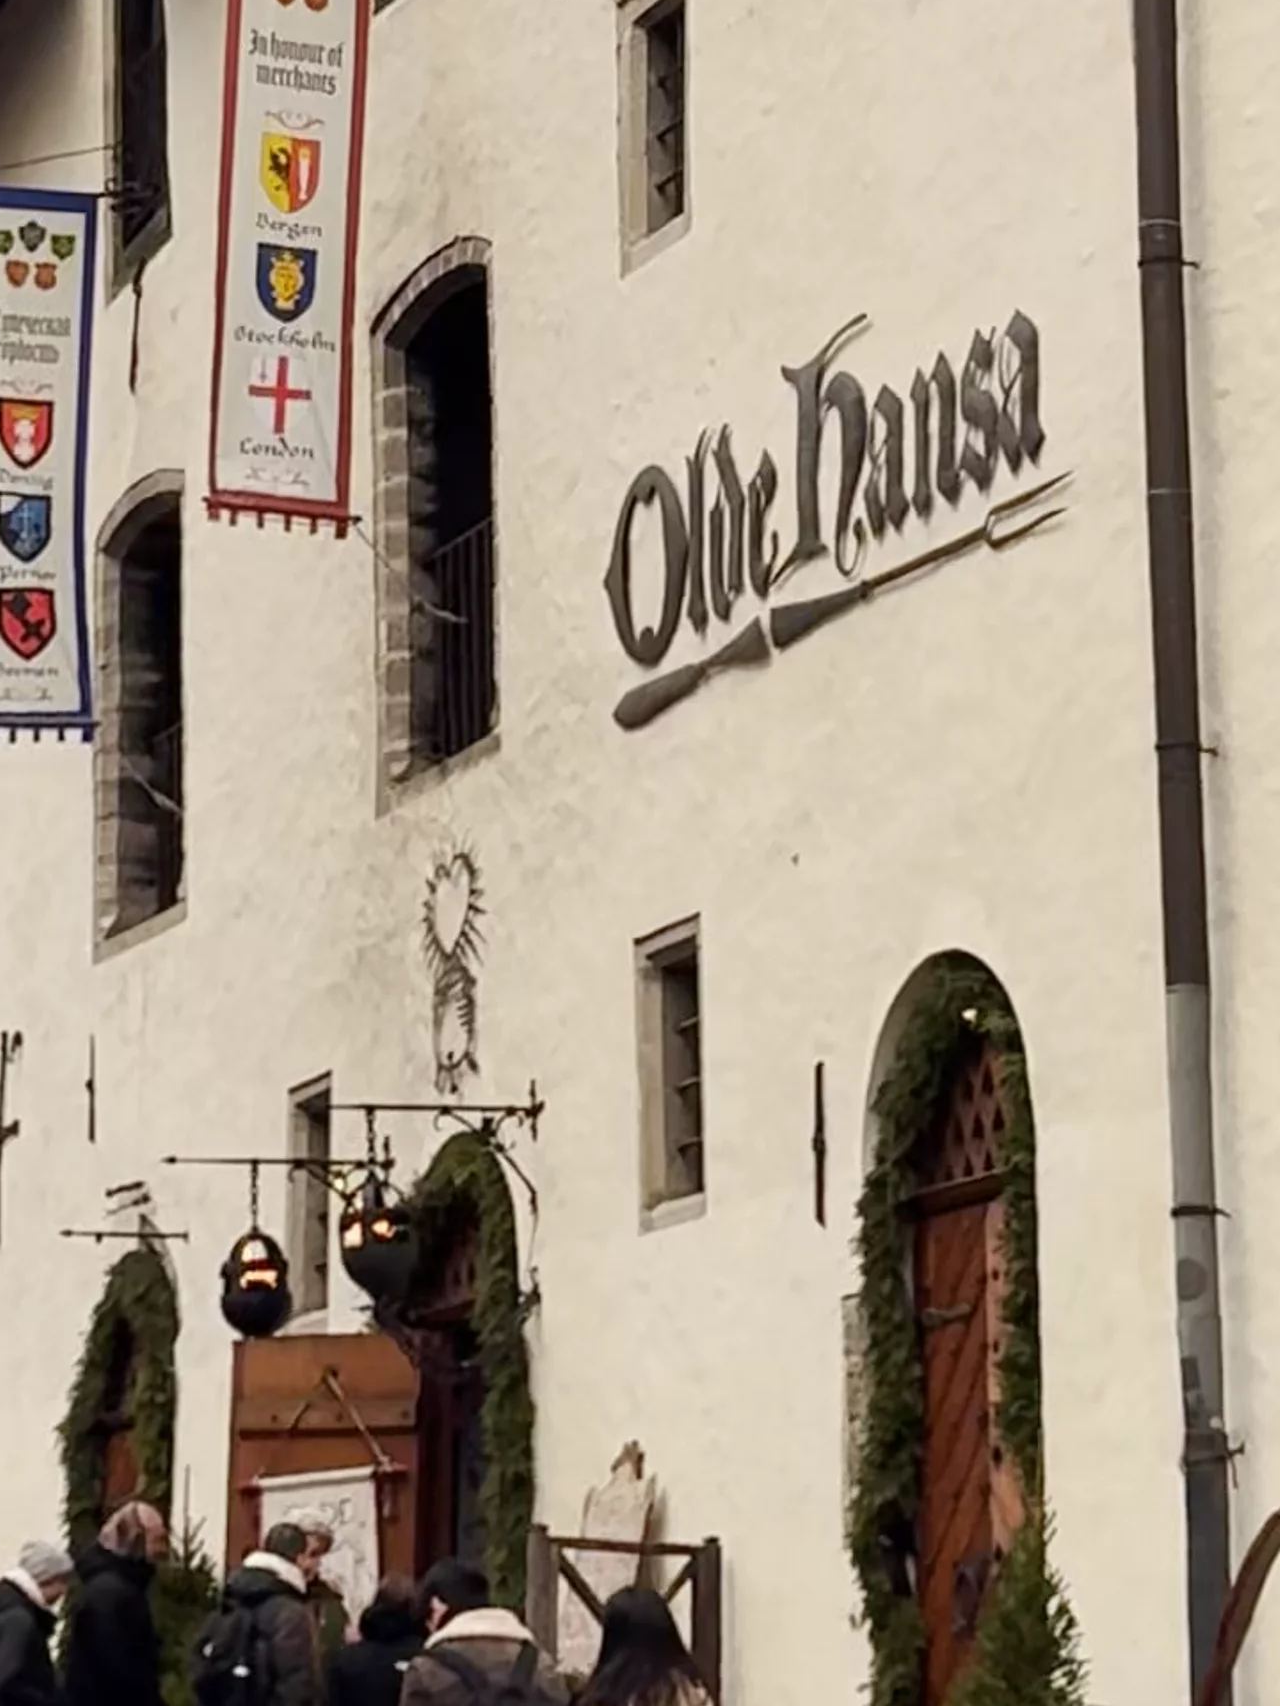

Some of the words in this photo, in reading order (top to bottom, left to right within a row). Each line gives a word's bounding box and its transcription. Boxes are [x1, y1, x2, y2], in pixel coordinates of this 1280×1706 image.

[270, 31, 325, 64] honour
[327, 41, 345, 68] of
[256, 65, 336, 95] merchants
[255, 212, 322, 239] Bergen
[234, 325, 336, 352] Stockholm
[240, 437, 314, 459] London
[603, 422, 778, 668] Olde
